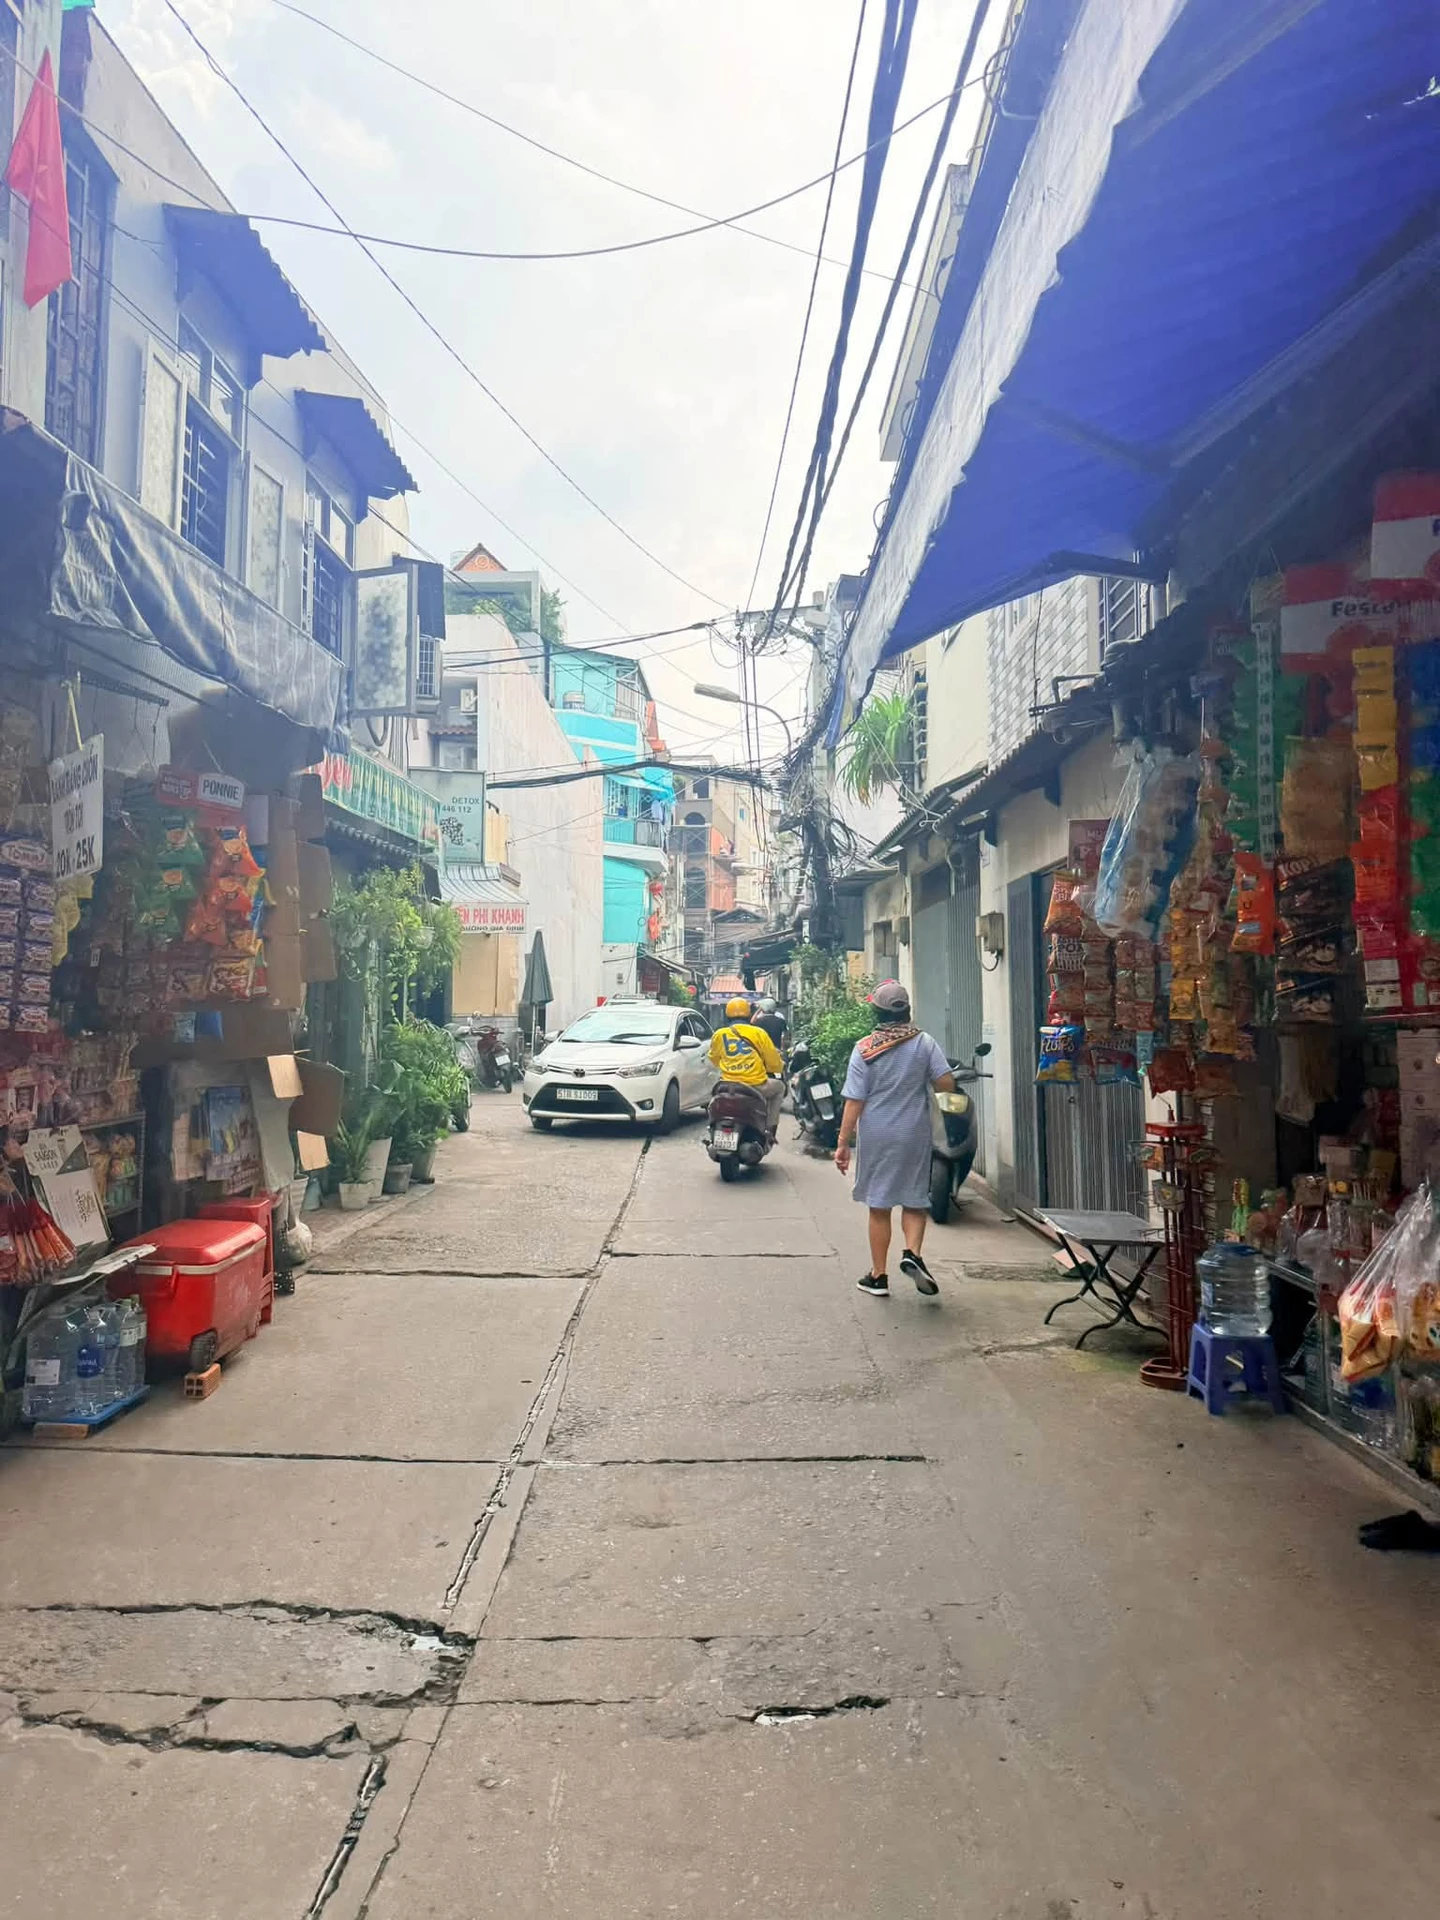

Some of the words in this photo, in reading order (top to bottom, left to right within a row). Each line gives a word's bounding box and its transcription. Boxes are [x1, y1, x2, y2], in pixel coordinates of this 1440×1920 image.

[452, 796, 480, 805] DETOX
[458, 806, 472, 814] 112
[76, 834, 95, 869] 25K
[473, 907, 488, 924] PHI
[491, 907, 525, 924] KHANH
[722, 1033, 754, 1057] be
